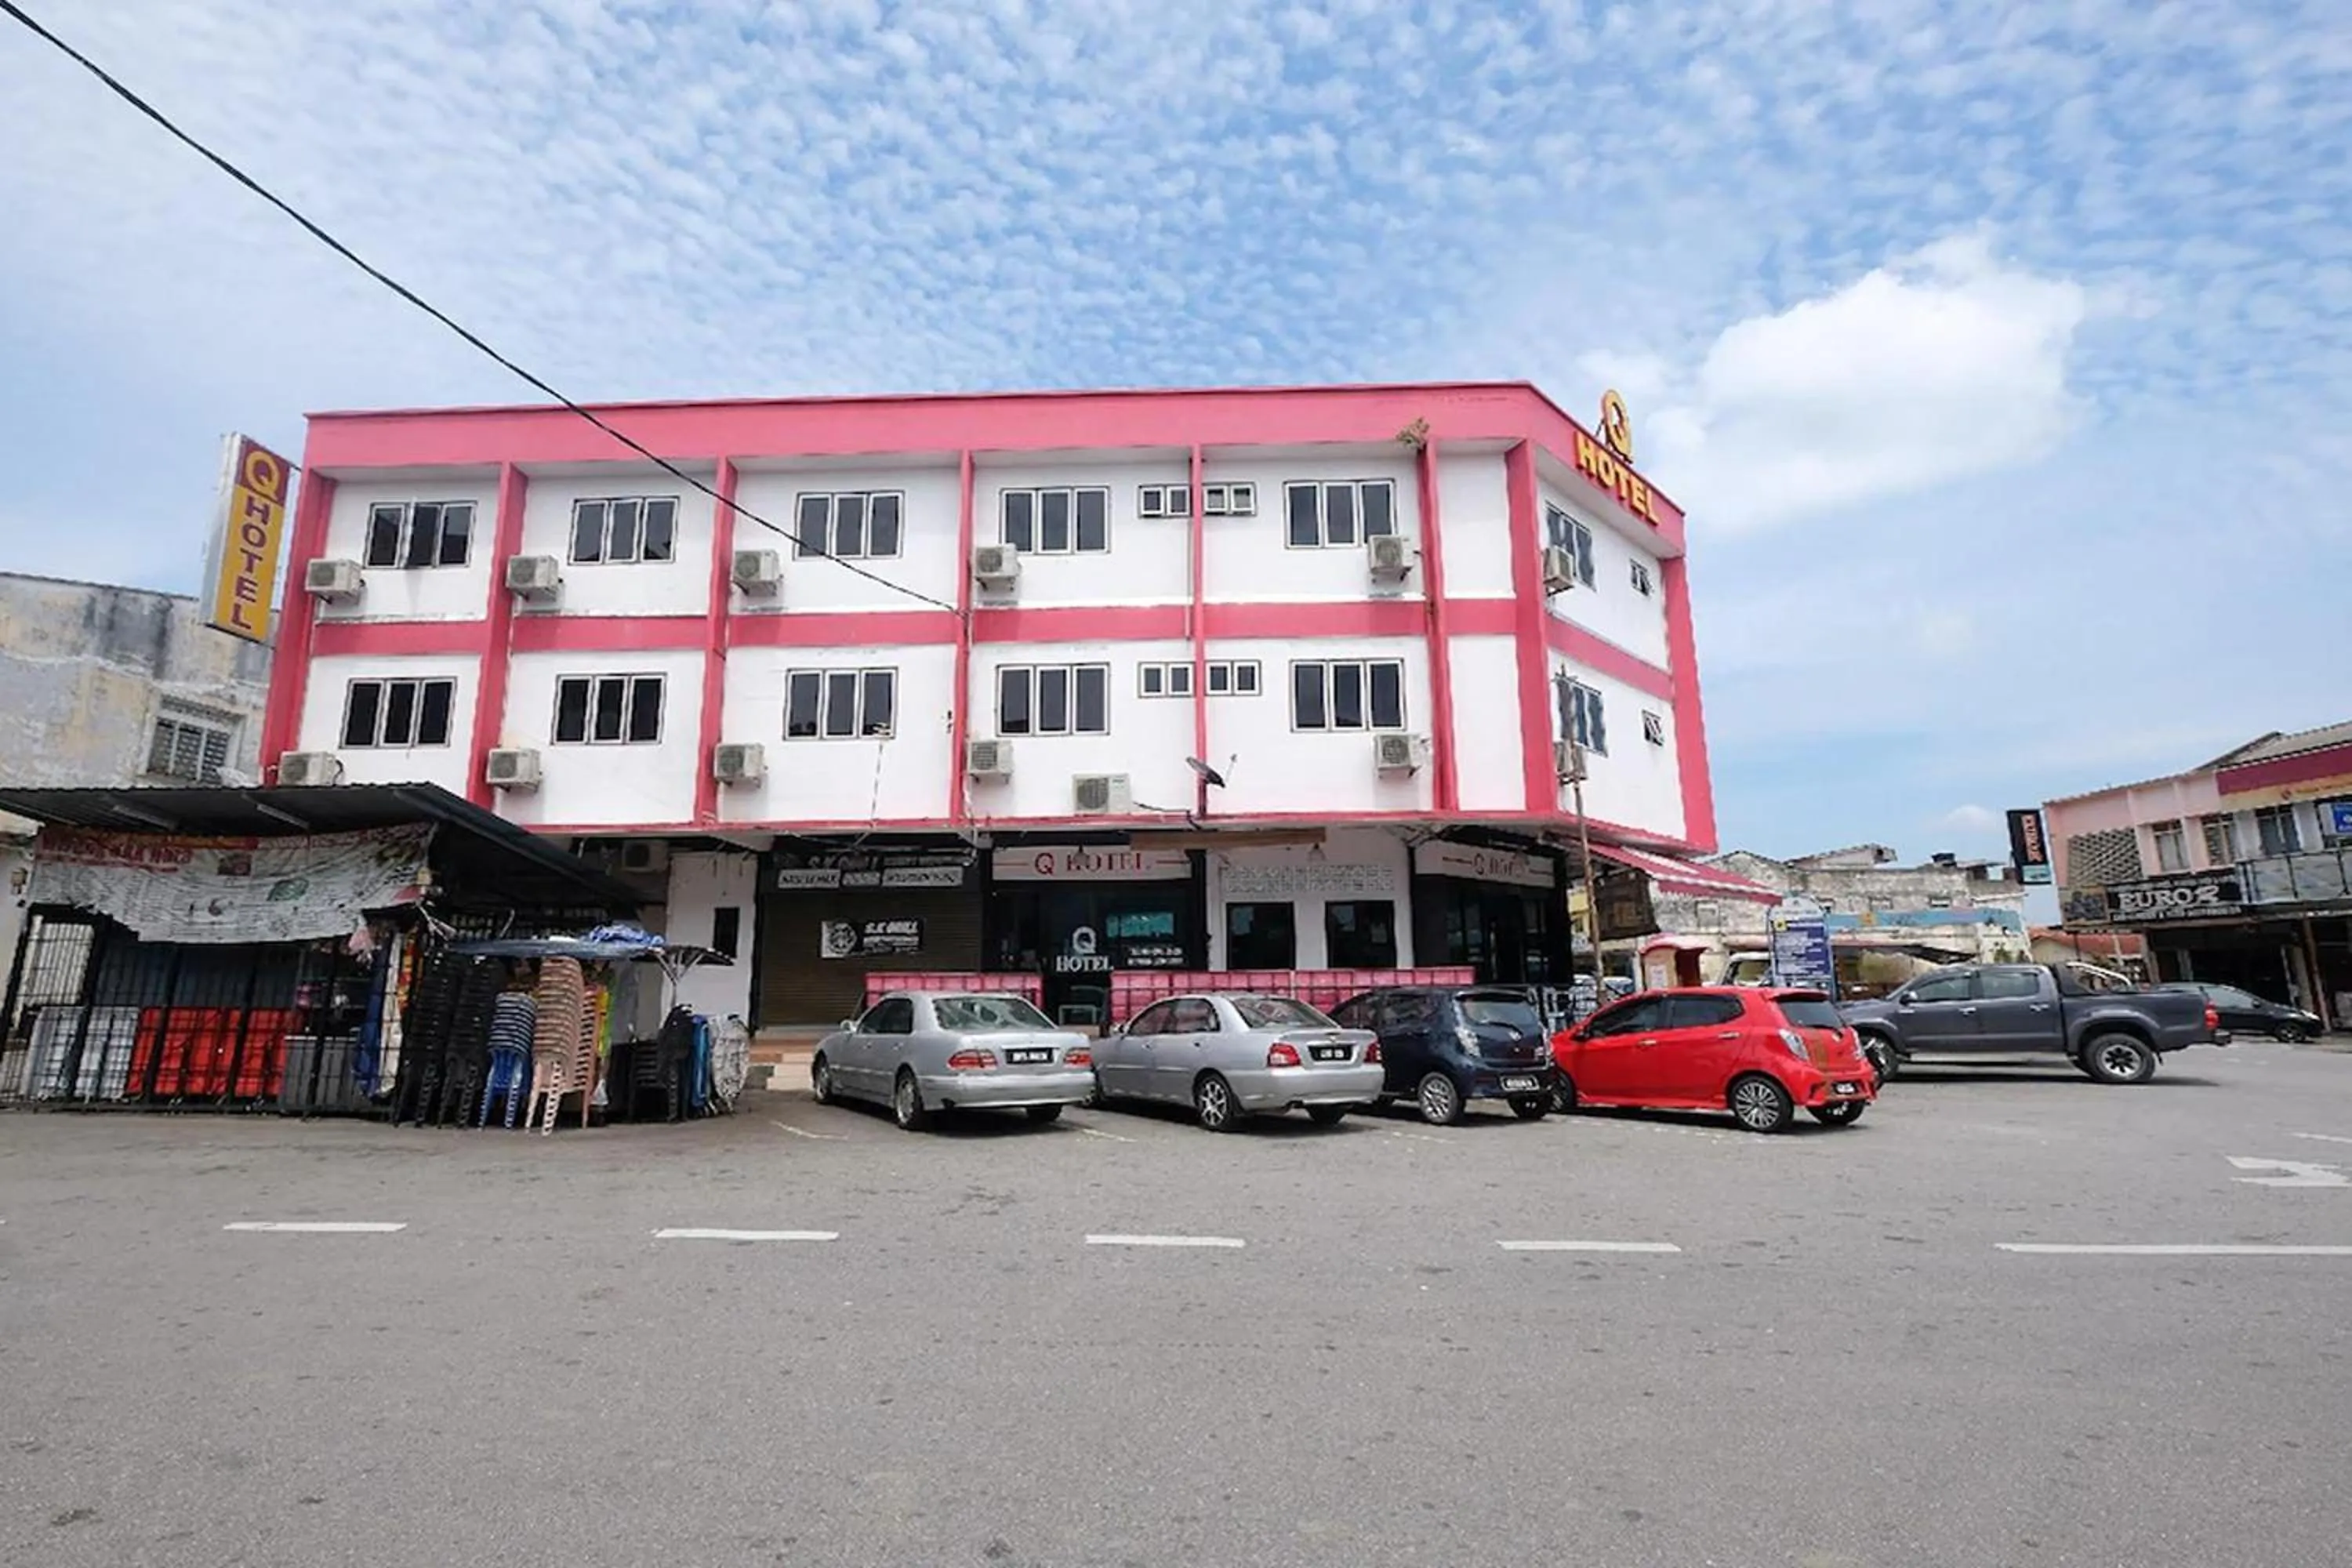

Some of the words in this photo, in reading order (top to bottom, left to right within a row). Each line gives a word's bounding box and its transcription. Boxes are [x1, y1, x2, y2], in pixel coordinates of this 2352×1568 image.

[245, 450, 280, 501] Q
[1574, 430, 1660, 527] HOTEL
[230, 495, 270, 629] HOTEL
[1034, 851, 1055, 875] Q
[1073, 926, 1096, 954] Q
[1056, 955, 1114, 972] HOTEL
